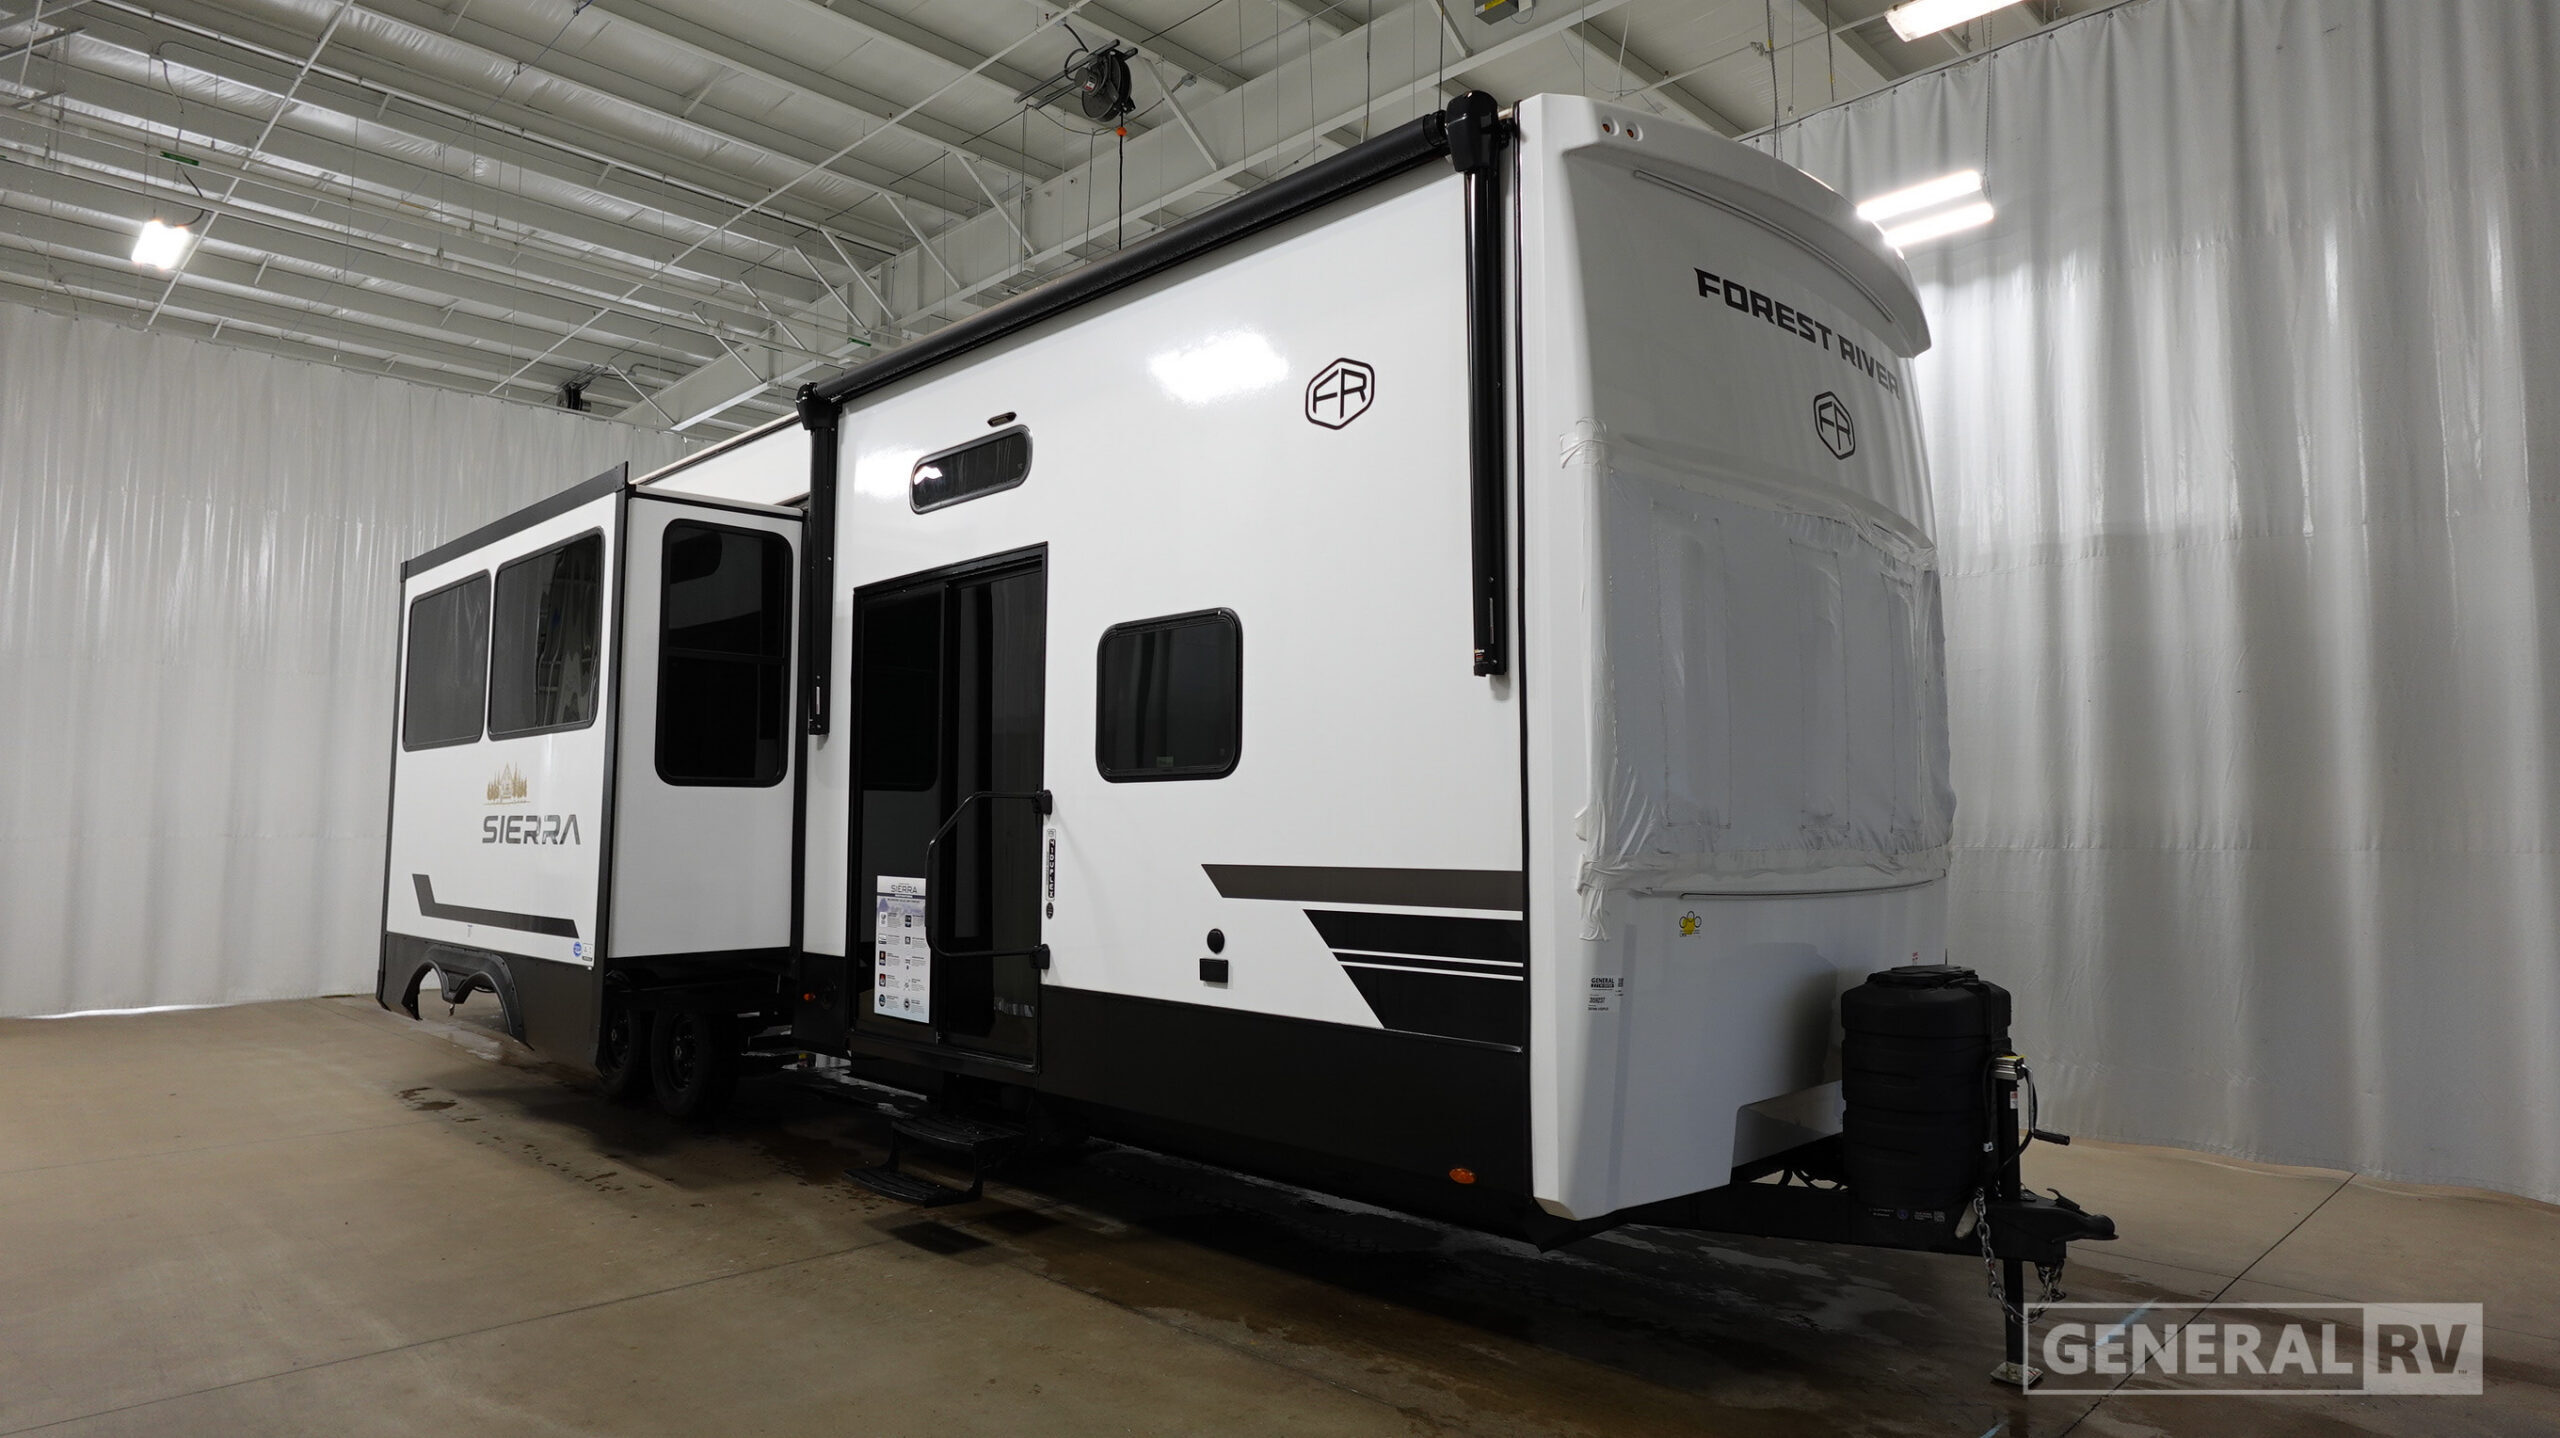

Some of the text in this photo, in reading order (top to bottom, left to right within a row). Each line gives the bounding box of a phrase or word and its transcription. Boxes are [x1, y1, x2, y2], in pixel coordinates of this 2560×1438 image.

[1694, 267, 1901, 400] FOREST RIVER
[1312, 368, 1367, 419] FR
[1819, 401, 1852, 450] FR
[482, 814, 581, 845] SIERRA
[891, 885, 917, 893] SIERRA
